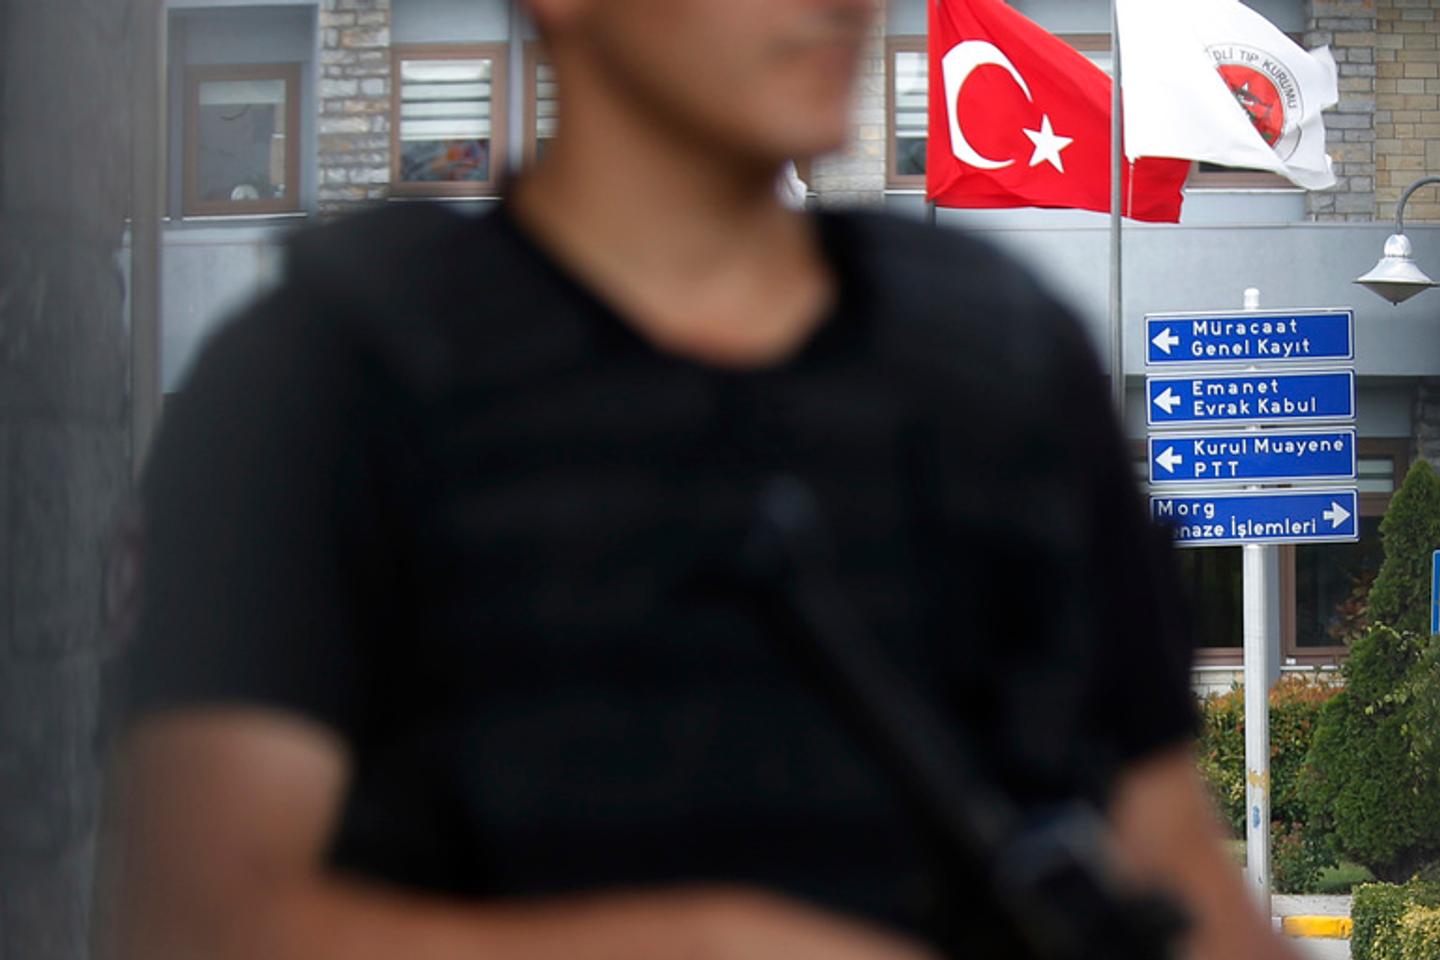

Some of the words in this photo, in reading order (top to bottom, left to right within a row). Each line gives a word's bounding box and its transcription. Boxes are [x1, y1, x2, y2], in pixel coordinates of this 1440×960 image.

[1211, 47, 1233, 62] DLİ
[1191, 339, 1250, 356] Genel
[1257, 338, 1310, 358] Kayıt
[1192, 379, 1279, 396] Emanet
[1193, 399, 1250, 416] Evrak
[1257, 397, 1316, 414] Kabul
[1194, 439, 1247, 456] Kurul
[1254, 438, 1344, 457] Muayene
[1194, 461, 1239, 478] PTT
[1158, 500, 1215, 519] Morg
[1231, 515, 1317, 538] İşlemleri
